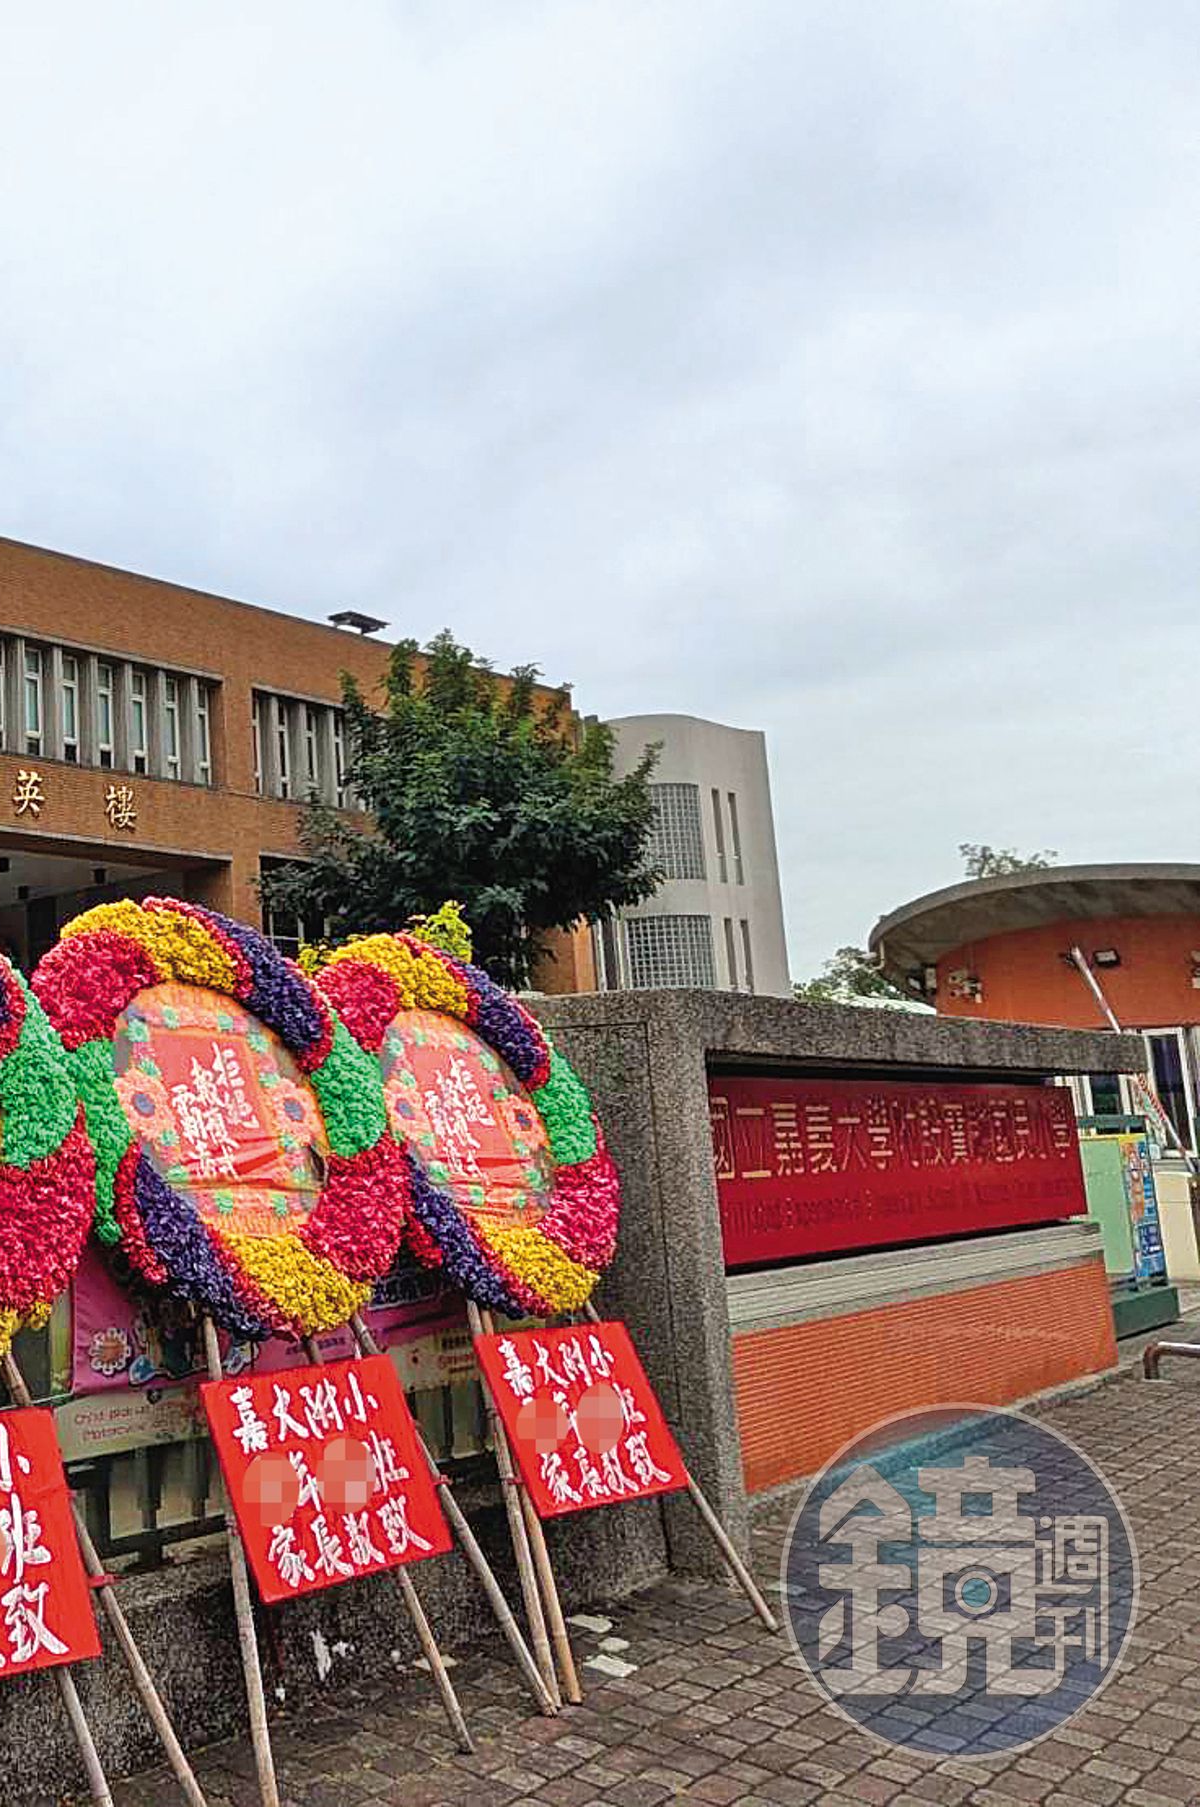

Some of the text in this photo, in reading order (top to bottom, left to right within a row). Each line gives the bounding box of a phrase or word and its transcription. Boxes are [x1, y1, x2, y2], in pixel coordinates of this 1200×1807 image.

[212, 1041, 259, 1128] 拒絕
[498, 1334, 615, 1397] 嘉大附小
[230, 1372, 378, 1454] 嘉大附小
[540, 1430, 673, 1504] 家長敬致
[268, 1495, 433, 1588] 家長敬致
